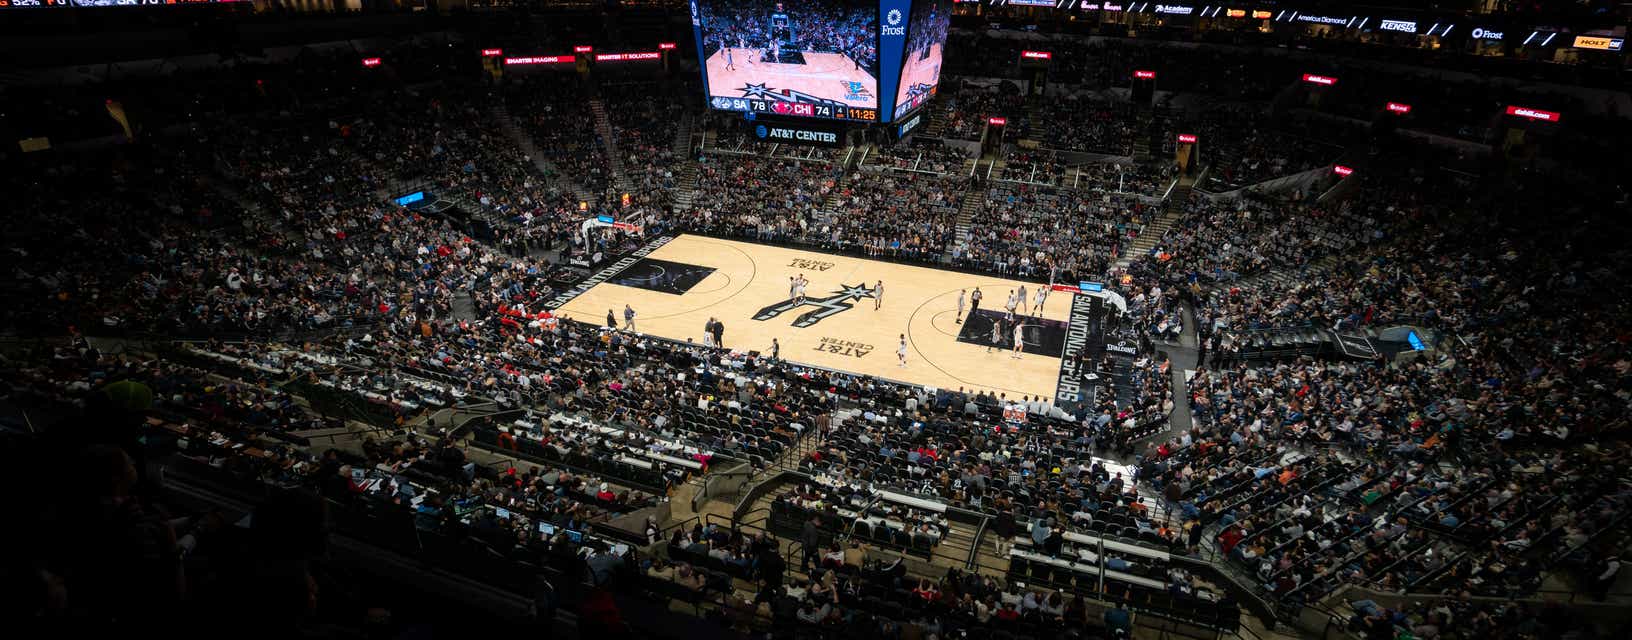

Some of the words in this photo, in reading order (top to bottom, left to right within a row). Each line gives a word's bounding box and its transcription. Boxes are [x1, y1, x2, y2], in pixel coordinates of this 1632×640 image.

[1164, 5, 1193, 14] Academy
[1321, 16, 1347, 24] Diamond
[881, 25, 905, 36] Frost
[1482, 30, 1503, 40] Frost
[733, 99, 747, 108] SA
[752, 101, 766, 111] 78
[794, 104, 812, 115] CHI
[815, 106, 830, 116] 74
[849, 108, 876, 120] 11:25
[770, 128, 794, 138] AT&T
[796, 130, 837, 143] CENTER
[544, 289, 581, 308] SAN
[576, 257, 637, 290] ANTONIO
[632, 235, 673, 258] SPURS
[1073, 295, 1091, 313] SAN
[820, 336, 874, 351] CENTER
[1106, 343, 1136, 354] SPALDING
[813, 343, 871, 358] AT&T
